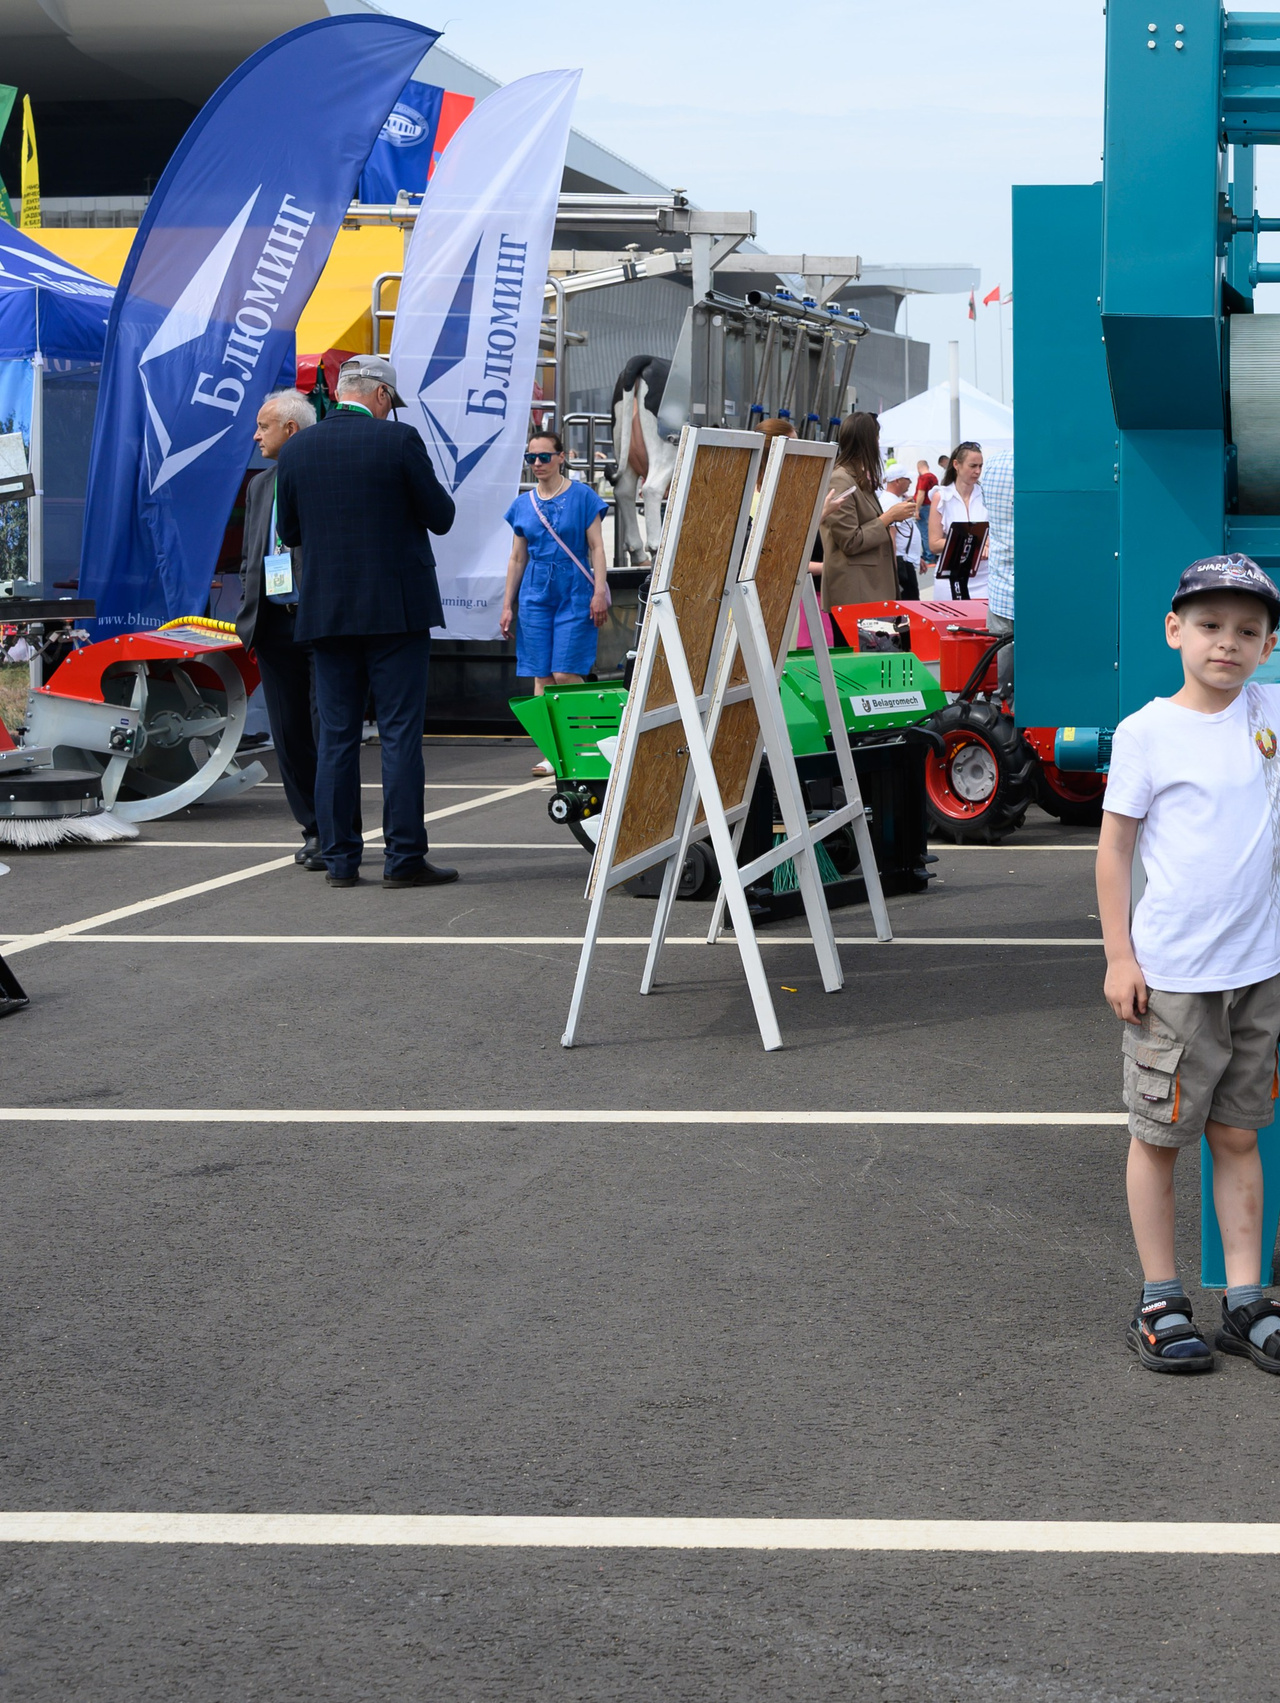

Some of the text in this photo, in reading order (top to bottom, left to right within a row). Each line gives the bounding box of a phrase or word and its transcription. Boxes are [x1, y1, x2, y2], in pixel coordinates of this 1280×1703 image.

[190, 193, 316, 417] БЛЮМИНГ
[465, 233, 528, 420] БЛЮМИНГ
[441, 596, 488, 610] uming.ru
[98, 612, 168, 627] www.blumi
[872, 696, 919, 708] Belagromech
